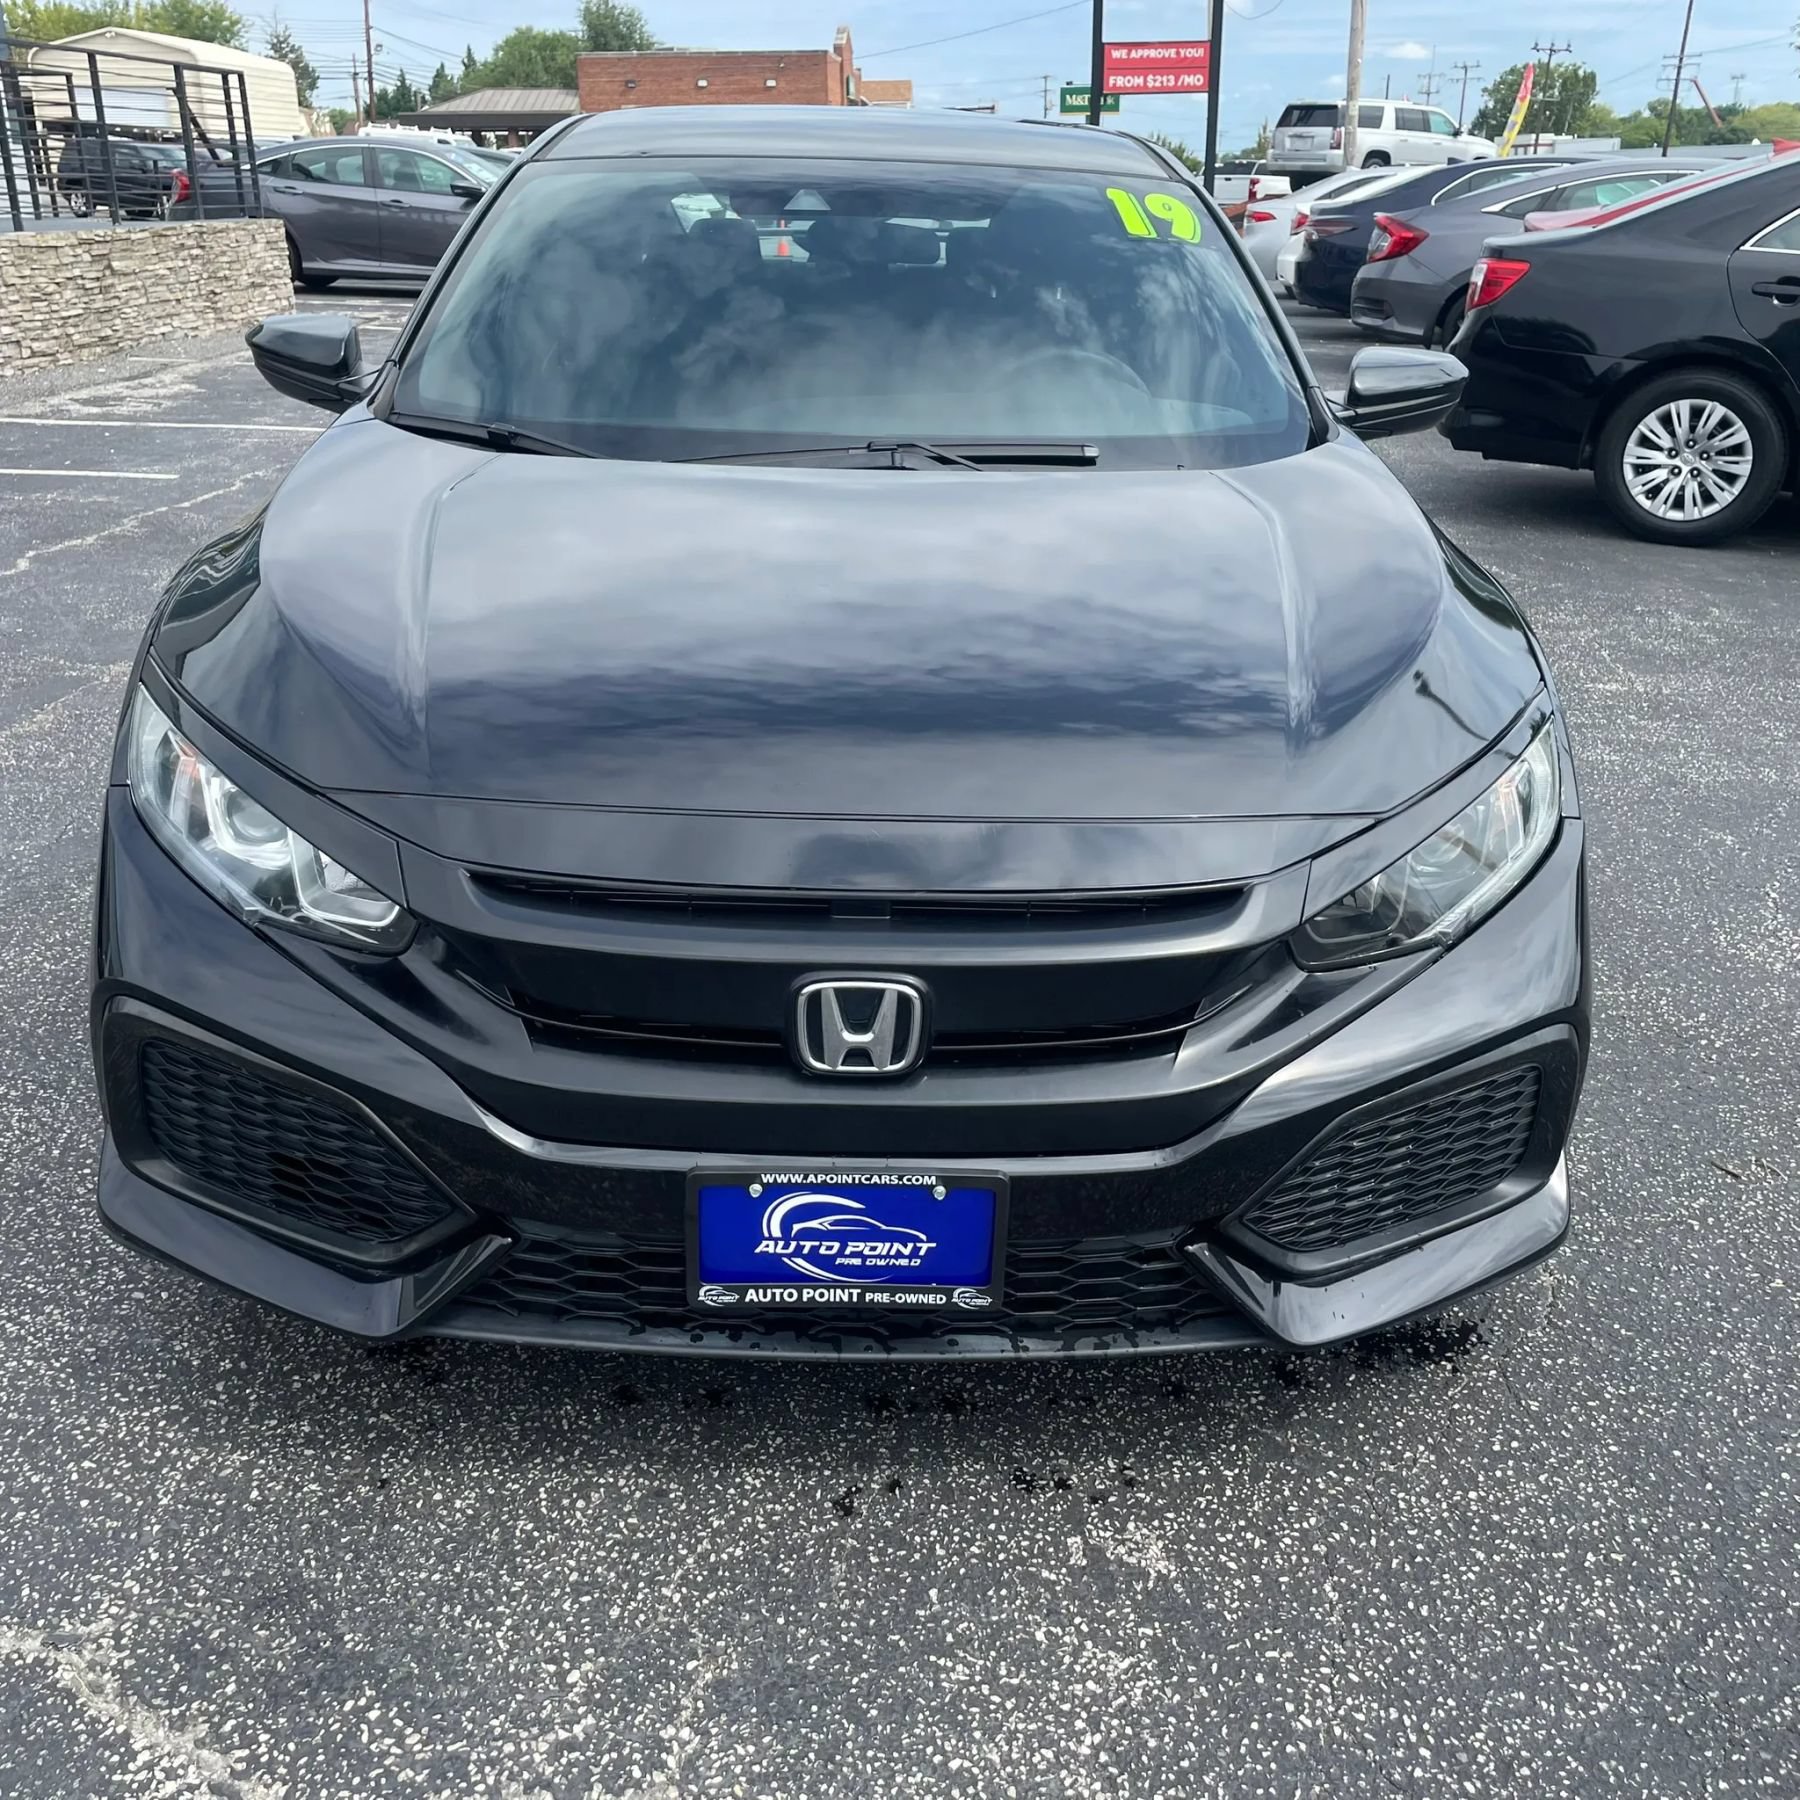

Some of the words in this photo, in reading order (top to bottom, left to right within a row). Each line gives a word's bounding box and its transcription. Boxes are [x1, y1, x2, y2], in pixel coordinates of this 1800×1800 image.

[1111, 49, 1128, 59] WE
[1129, 48, 1177, 59] APPROVE
[1179, 47, 1204, 58] YOU!
[1109, 75, 1143, 88] FROM
[1146, 74, 1175, 88] $213
[1177, 74, 1204, 87] /MO
[1106, 187, 1201, 244] 19
[761, 1173, 936, 1185] WWW.APOINTCARS.COM
[754, 1240, 838, 1255] AUTO
[844, 1241, 936, 1256] POINT
[835, 1257, 862, 1266] PRE
[865, 1257, 922, 1267] OWNED
[744, 1288, 798, 1303] AUTO
[802, 1289, 861, 1303] POINT
[865, 1293, 946, 1305] PRE-OWNED
